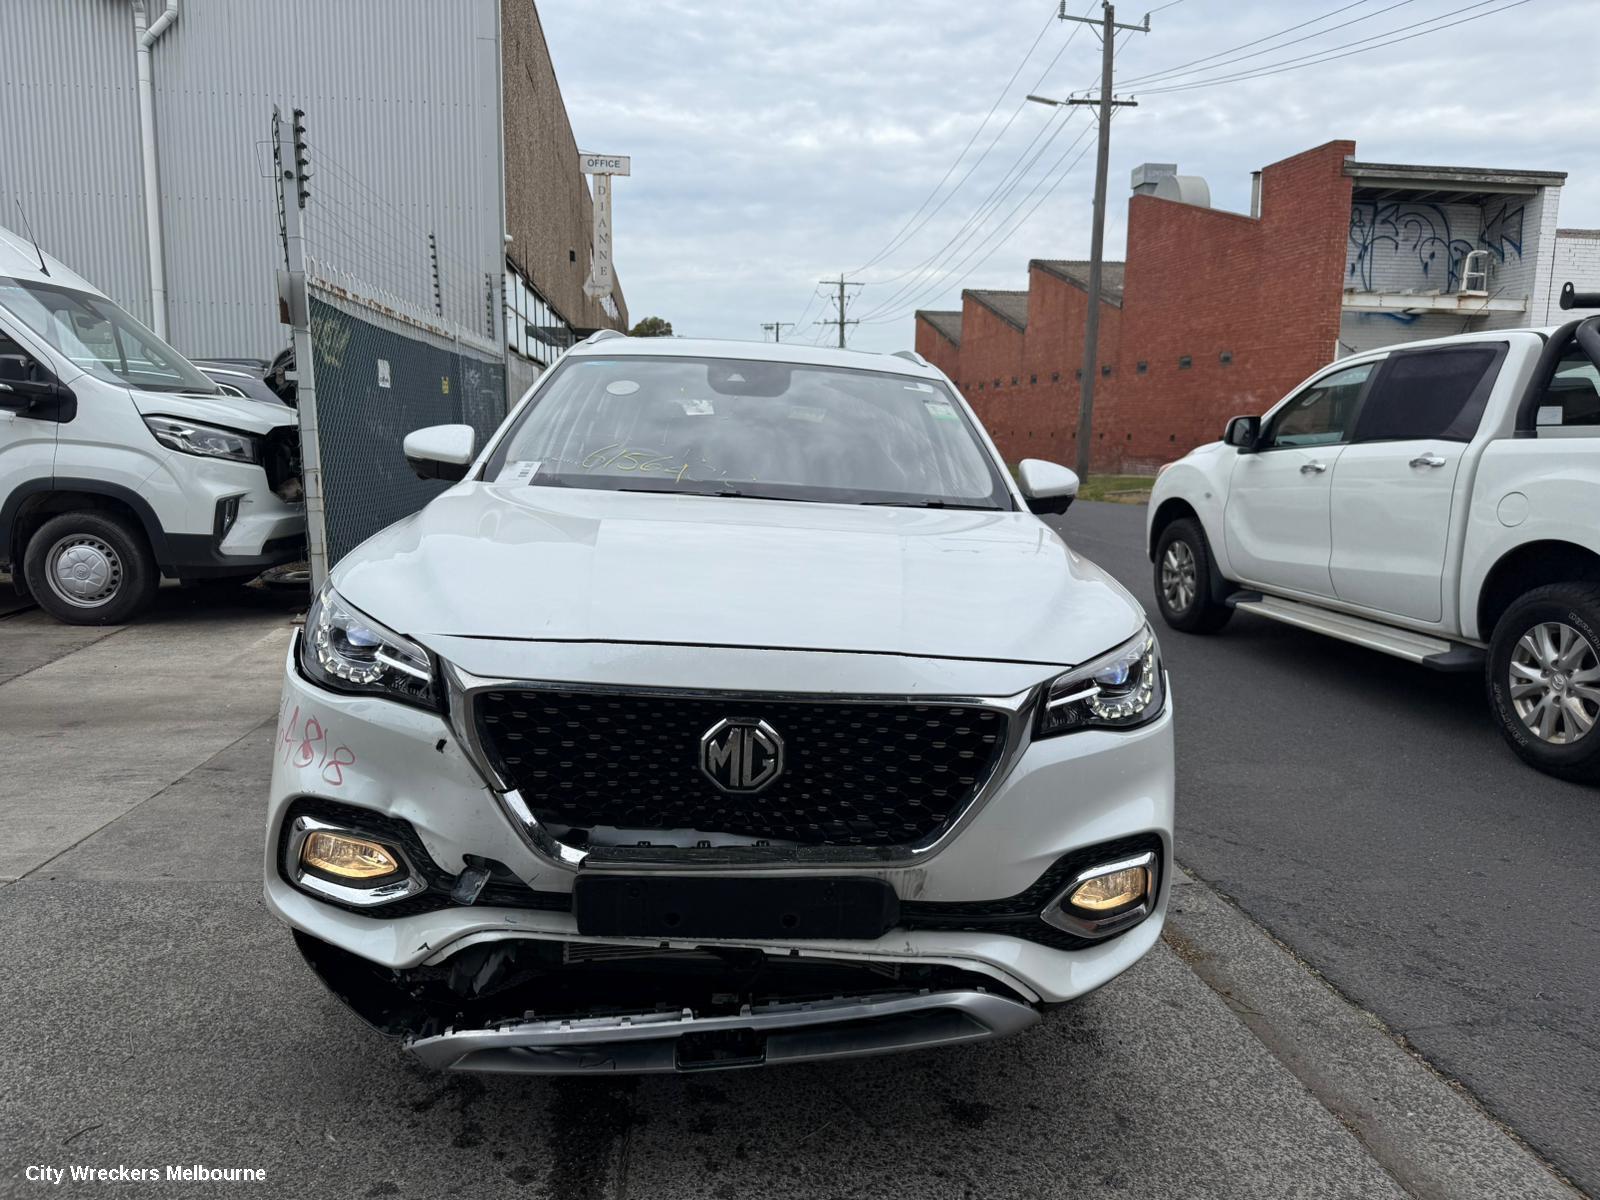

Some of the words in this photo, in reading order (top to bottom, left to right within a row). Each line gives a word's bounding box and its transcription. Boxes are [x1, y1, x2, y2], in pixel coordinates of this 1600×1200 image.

[587, 158, 621, 169] OFFICE
[597, 185, 609, 276] DIANNE
[708, 727, 776, 787] MG
